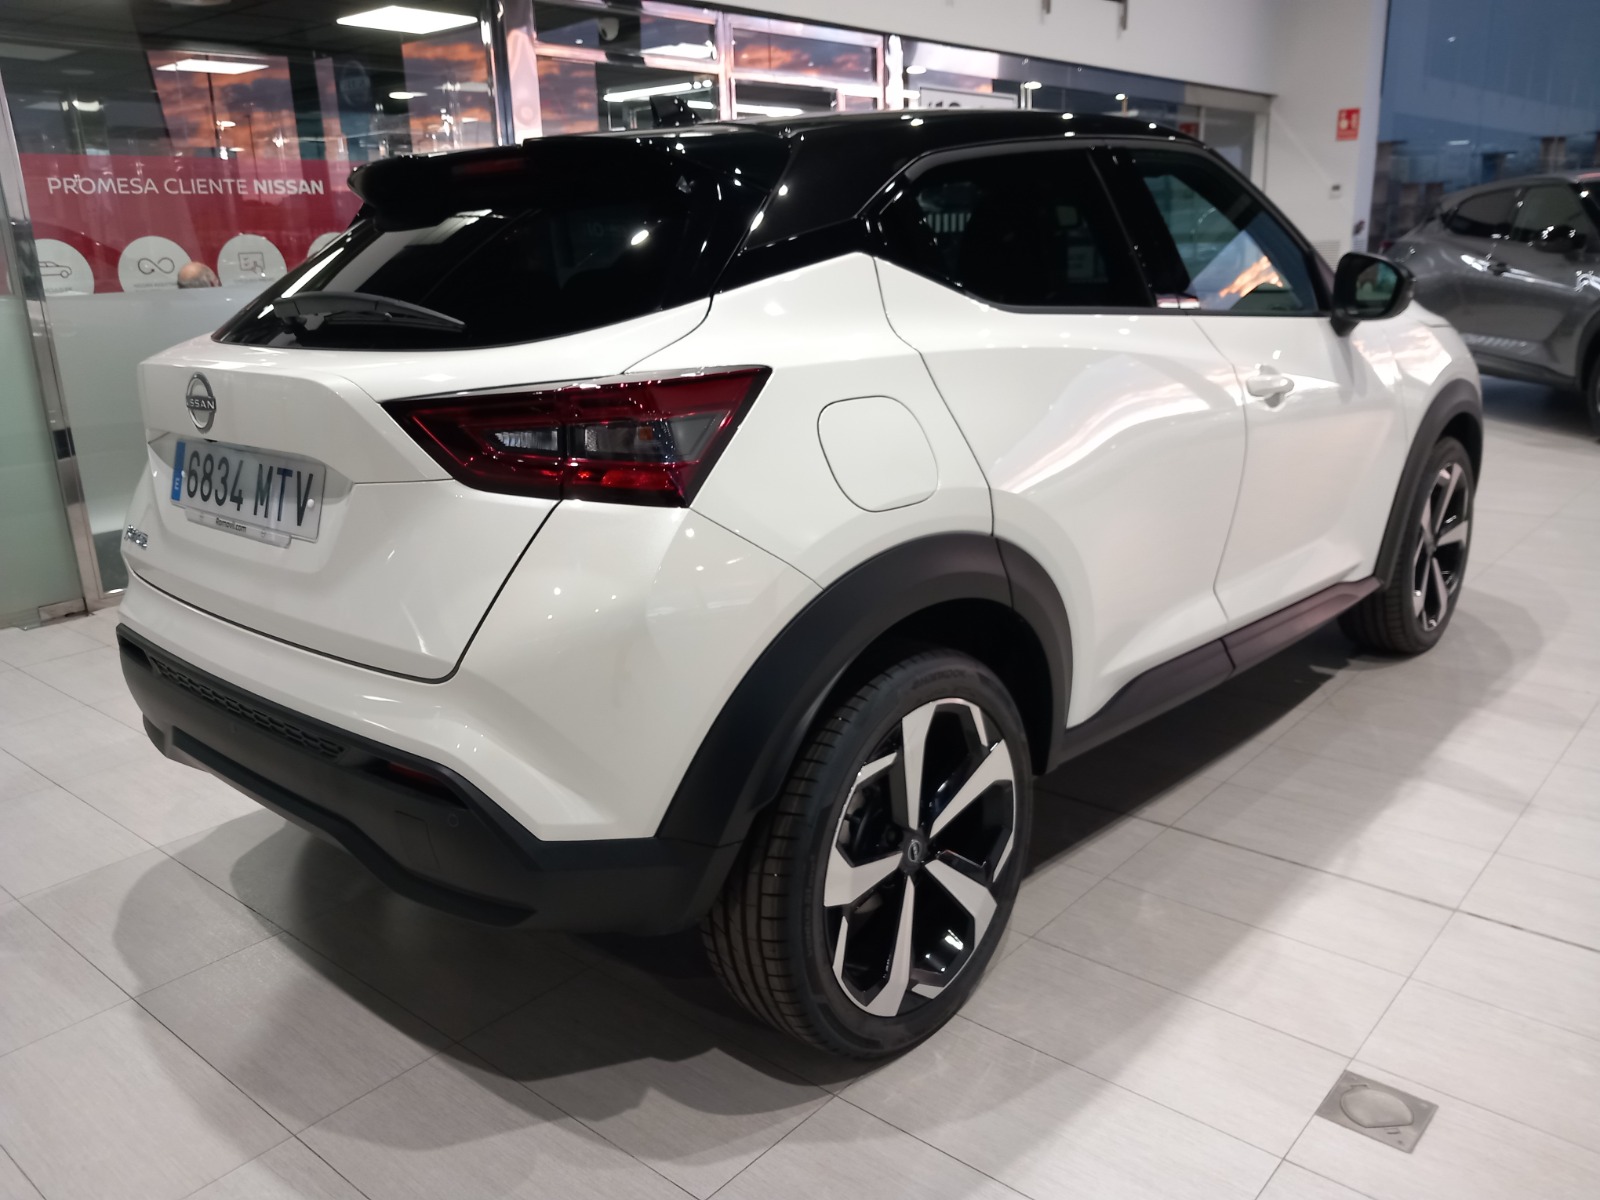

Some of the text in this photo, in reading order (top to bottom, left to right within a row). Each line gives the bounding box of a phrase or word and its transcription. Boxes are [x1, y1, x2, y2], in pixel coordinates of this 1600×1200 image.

[47, 177, 324, 195] PROMESA CLIENTE NISSAN
[186, 398, 215, 410] SSAN
[187, 450, 313, 527] 6834 MTV
